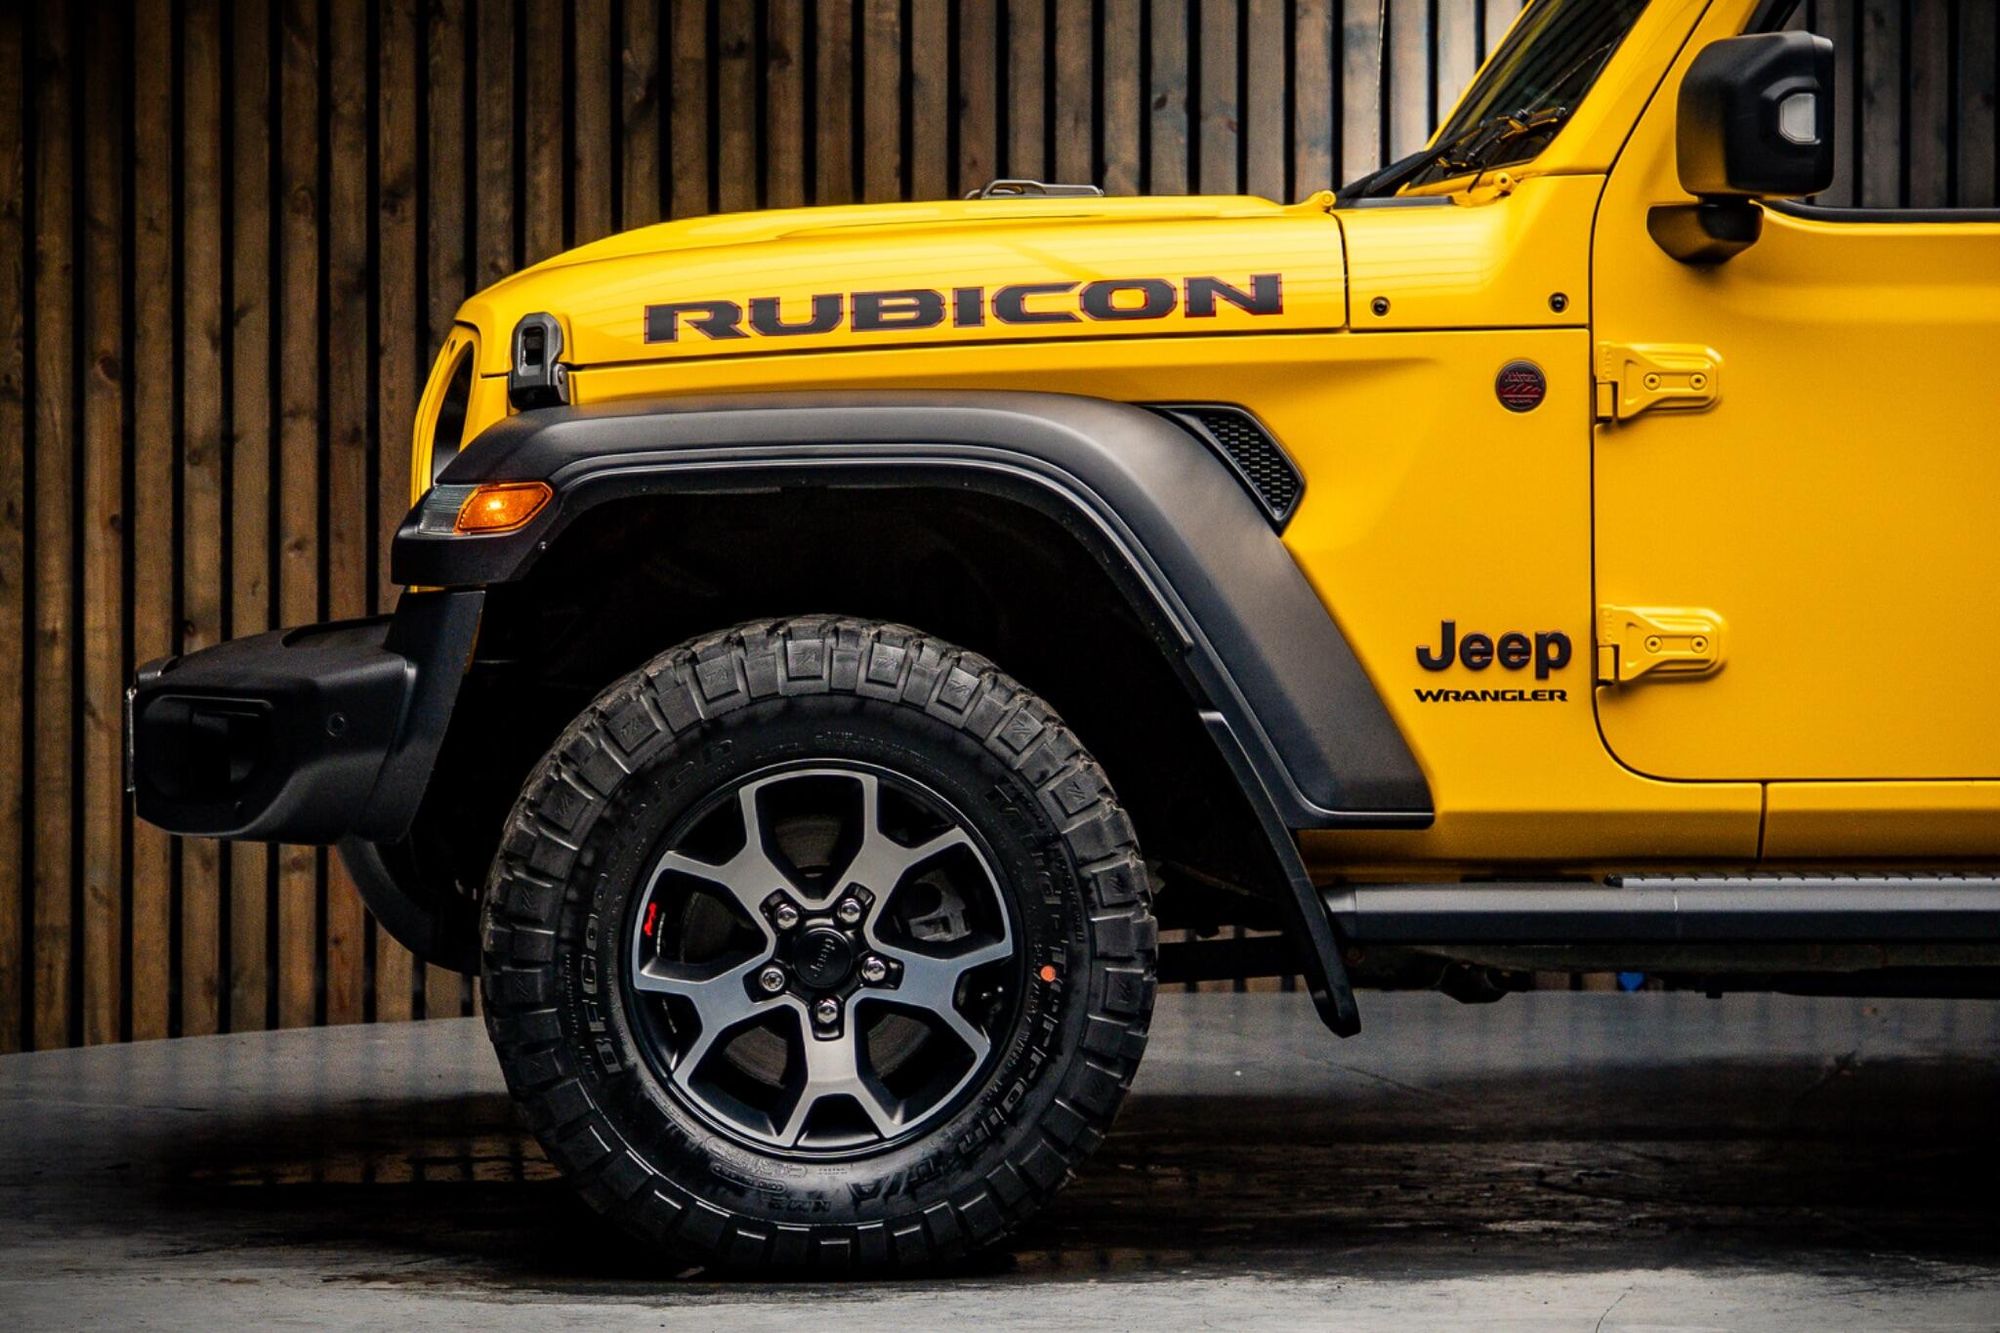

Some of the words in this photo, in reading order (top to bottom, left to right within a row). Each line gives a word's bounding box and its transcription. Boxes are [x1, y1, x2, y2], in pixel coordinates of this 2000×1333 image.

[644, 273, 1283, 344] RUBICON
[1416, 620, 1572, 680] Jeep
[1414, 689, 1568, 702] WRANGLER
